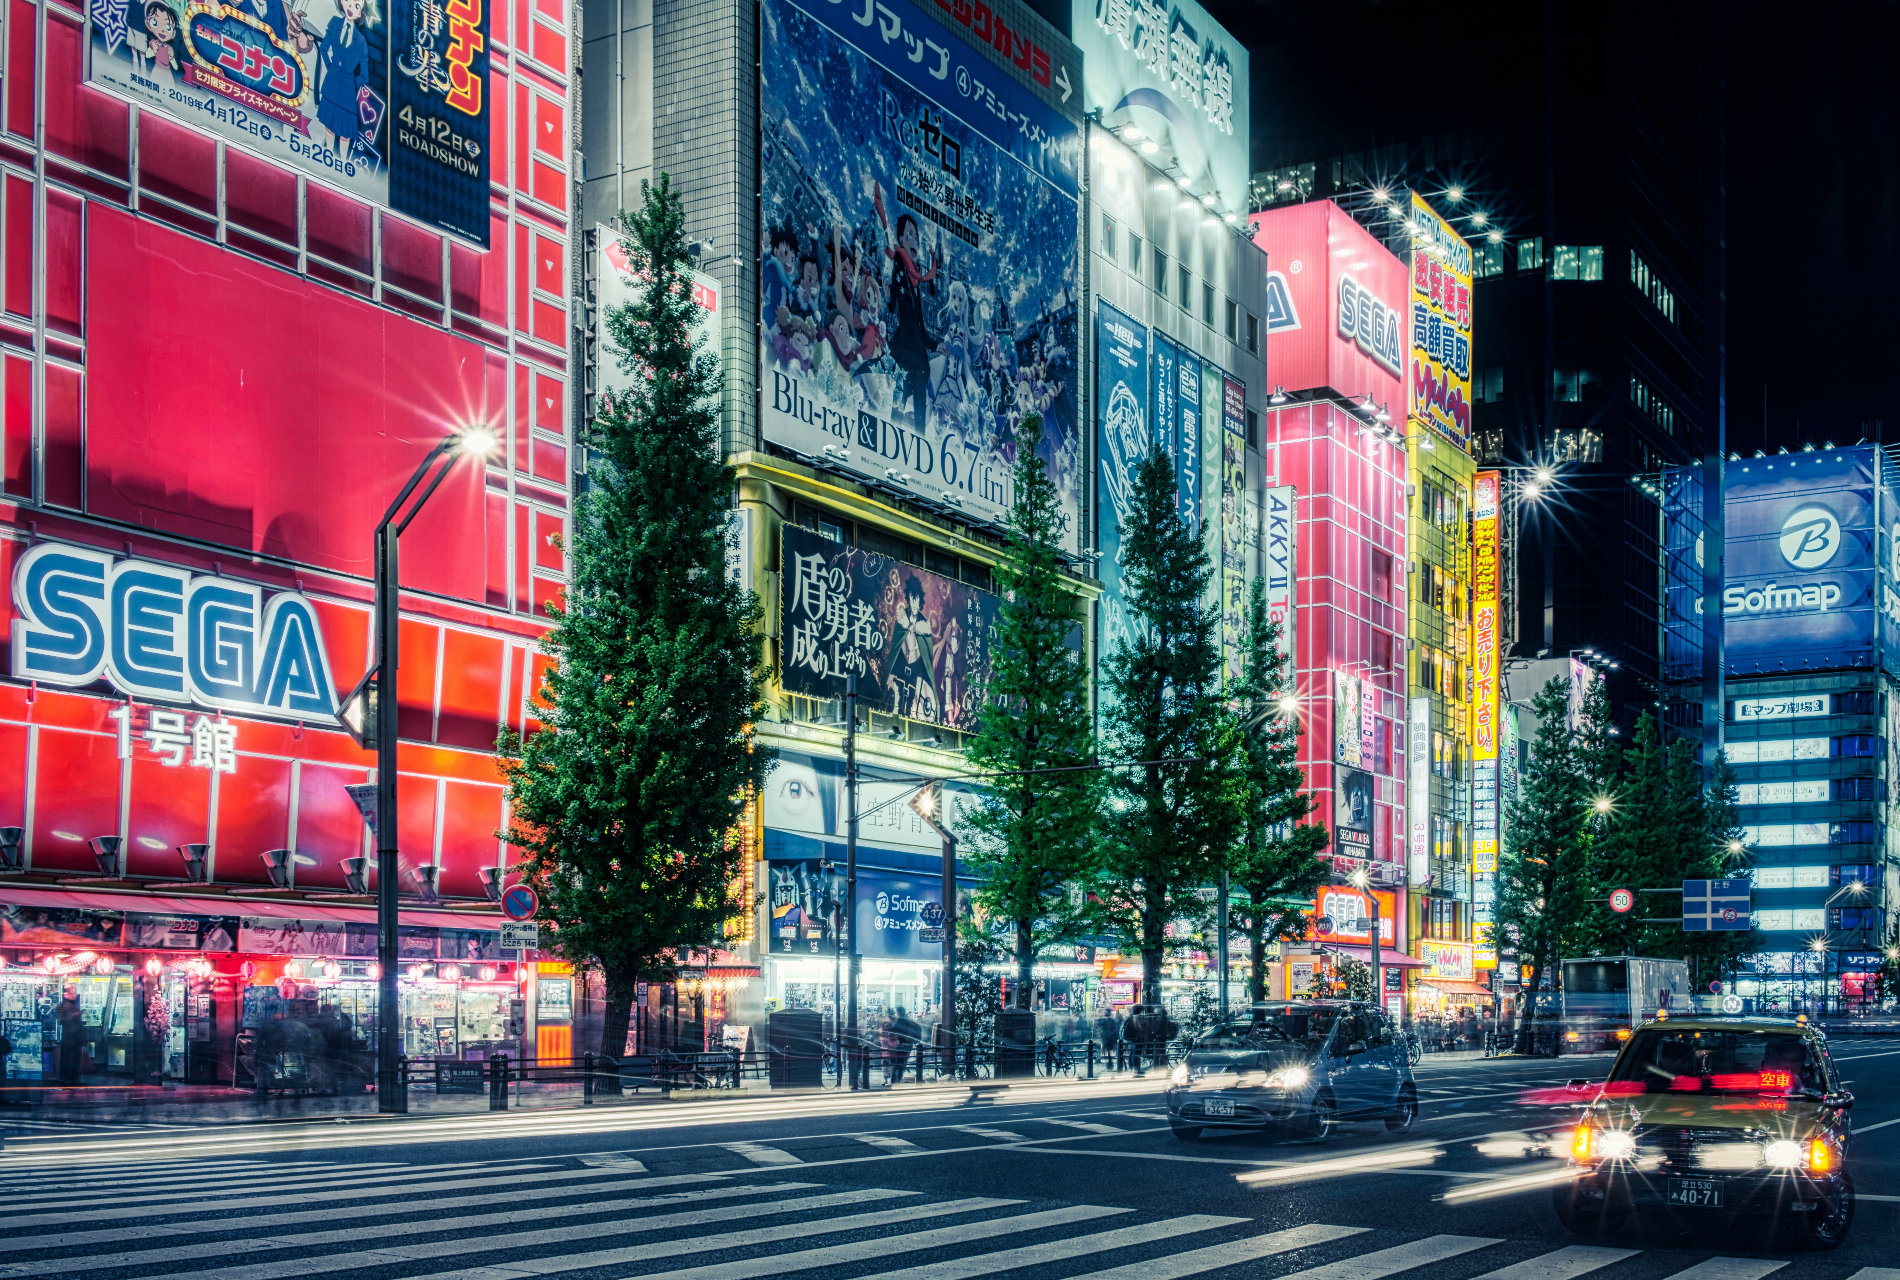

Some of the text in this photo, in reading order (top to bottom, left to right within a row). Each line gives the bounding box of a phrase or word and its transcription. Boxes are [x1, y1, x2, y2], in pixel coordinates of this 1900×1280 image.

[221, 27, 245, 44] CONAN
[217, 34, 295, 95] コナン
[195, 69, 298, 121] セガ限定プライズキャンペーン
[399, 128, 479, 177] ROADSHOW
[901, 160, 994, 235] から始める異世界生活
[1414, 247, 1470, 331] 激安販売
[1338, 273, 1403, 376] SEGA
[1413, 300, 1469, 382] 高額買取
[1413, 358, 1471, 439] Mulan
[772, 370, 855, 450] Blu-ray
[859, 409, 877, 450] &
[880, 425, 934, 475] DVD
[940, 433, 981, 494] 6.7
[1476, 520, 1495, 530] DVD
[1476, 537, 1495, 548] ゲーム
[1479, 547, 1493, 557] CD
[1476, 565, 1495, 574] アニメ
[1476, 573, 1495, 583] コミック
[1476, 583, 1495, 593] ホビー
[1724, 583, 1840, 613] Sofmap
[12, 543, 341, 727] SEGA
[790, 620, 867, 680] 成り上がり
[109, 705, 238, 774] 1号館
[1414, 722, 1425, 763] SEGA
[1476, 771, 1494, 780] DVD
[1476, 791, 1494, 800] DVD
[1476, 812, 1494, 820] DVD
[1340, 828, 1352, 842] SEGA
[1414, 823, 1425, 856] 3号館
[1713, 881, 1730, 889] 上野
[1615, 895, 1628, 906] 50
[923, 909, 942, 919] 437
[1324, 892, 1369, 937] SEGA
[172, 920, 198, 931] コナン
[1726, 1001, 1737, 1009] N
[1761, 1073, 1791, 1088] 空車
[1211, 1106, 1233, 1115] 36-57
[1682, 1181, 1696, 1189] 足立
[1680, 1190, 1718, 1205] 40-71
